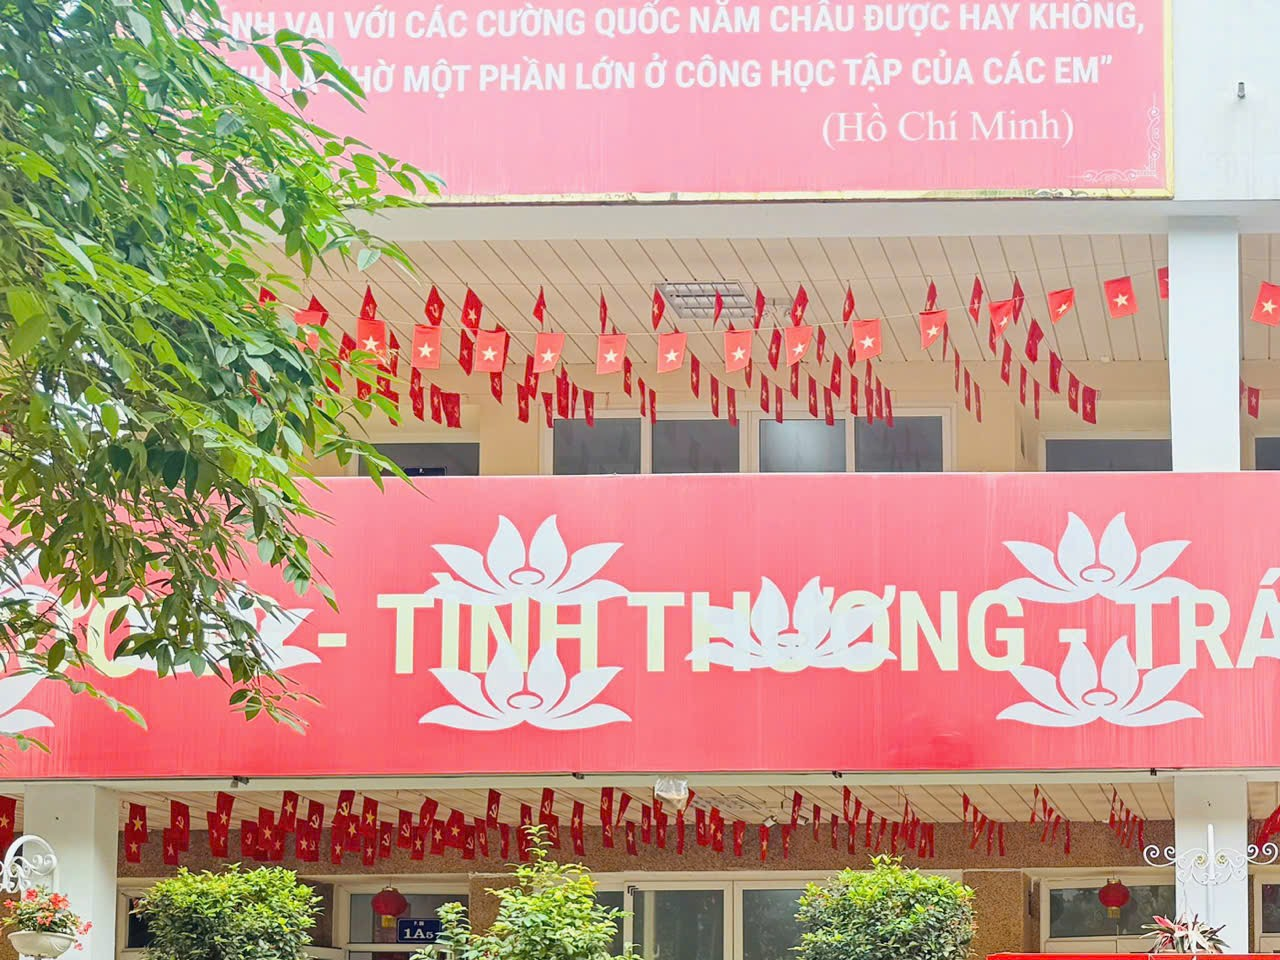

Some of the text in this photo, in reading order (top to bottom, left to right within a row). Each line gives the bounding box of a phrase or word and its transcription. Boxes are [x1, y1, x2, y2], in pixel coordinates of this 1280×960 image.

[345, 3, 395, 39] VỚI
[405, 3, 468, 39] CÁC
[476, 3, 586, 37] CƯỜNG
[595, 0, 680, 38] QUỐC
[690, 0, 760, 33] NĂM
[769, 0, 855, 32] CHÂU
[864, 2, 950, 37] ĐƯỢC
[960, 3, 1024, 30] HAY
[1029, 0, 1144, 34] KHÔNG,
[404, 59, 471, 99] MỘT
[479, 56, 566, 91] PHẦN
[575, 55, 635, 90] LỚN
[645, 52, 667, 89] Ở
[675, 54, 761, 88] CÔNG
[771, 59, 835, 93] HỌC
[844, 52, 902, 92] TẬP
[912, 49, 974, 85] CỦA
[983, 50, 1046, 84] CÁC
[822, 103, 1074, 149] (Hồ Chí Minh)
[404, 928, 434, 939] 1A5
